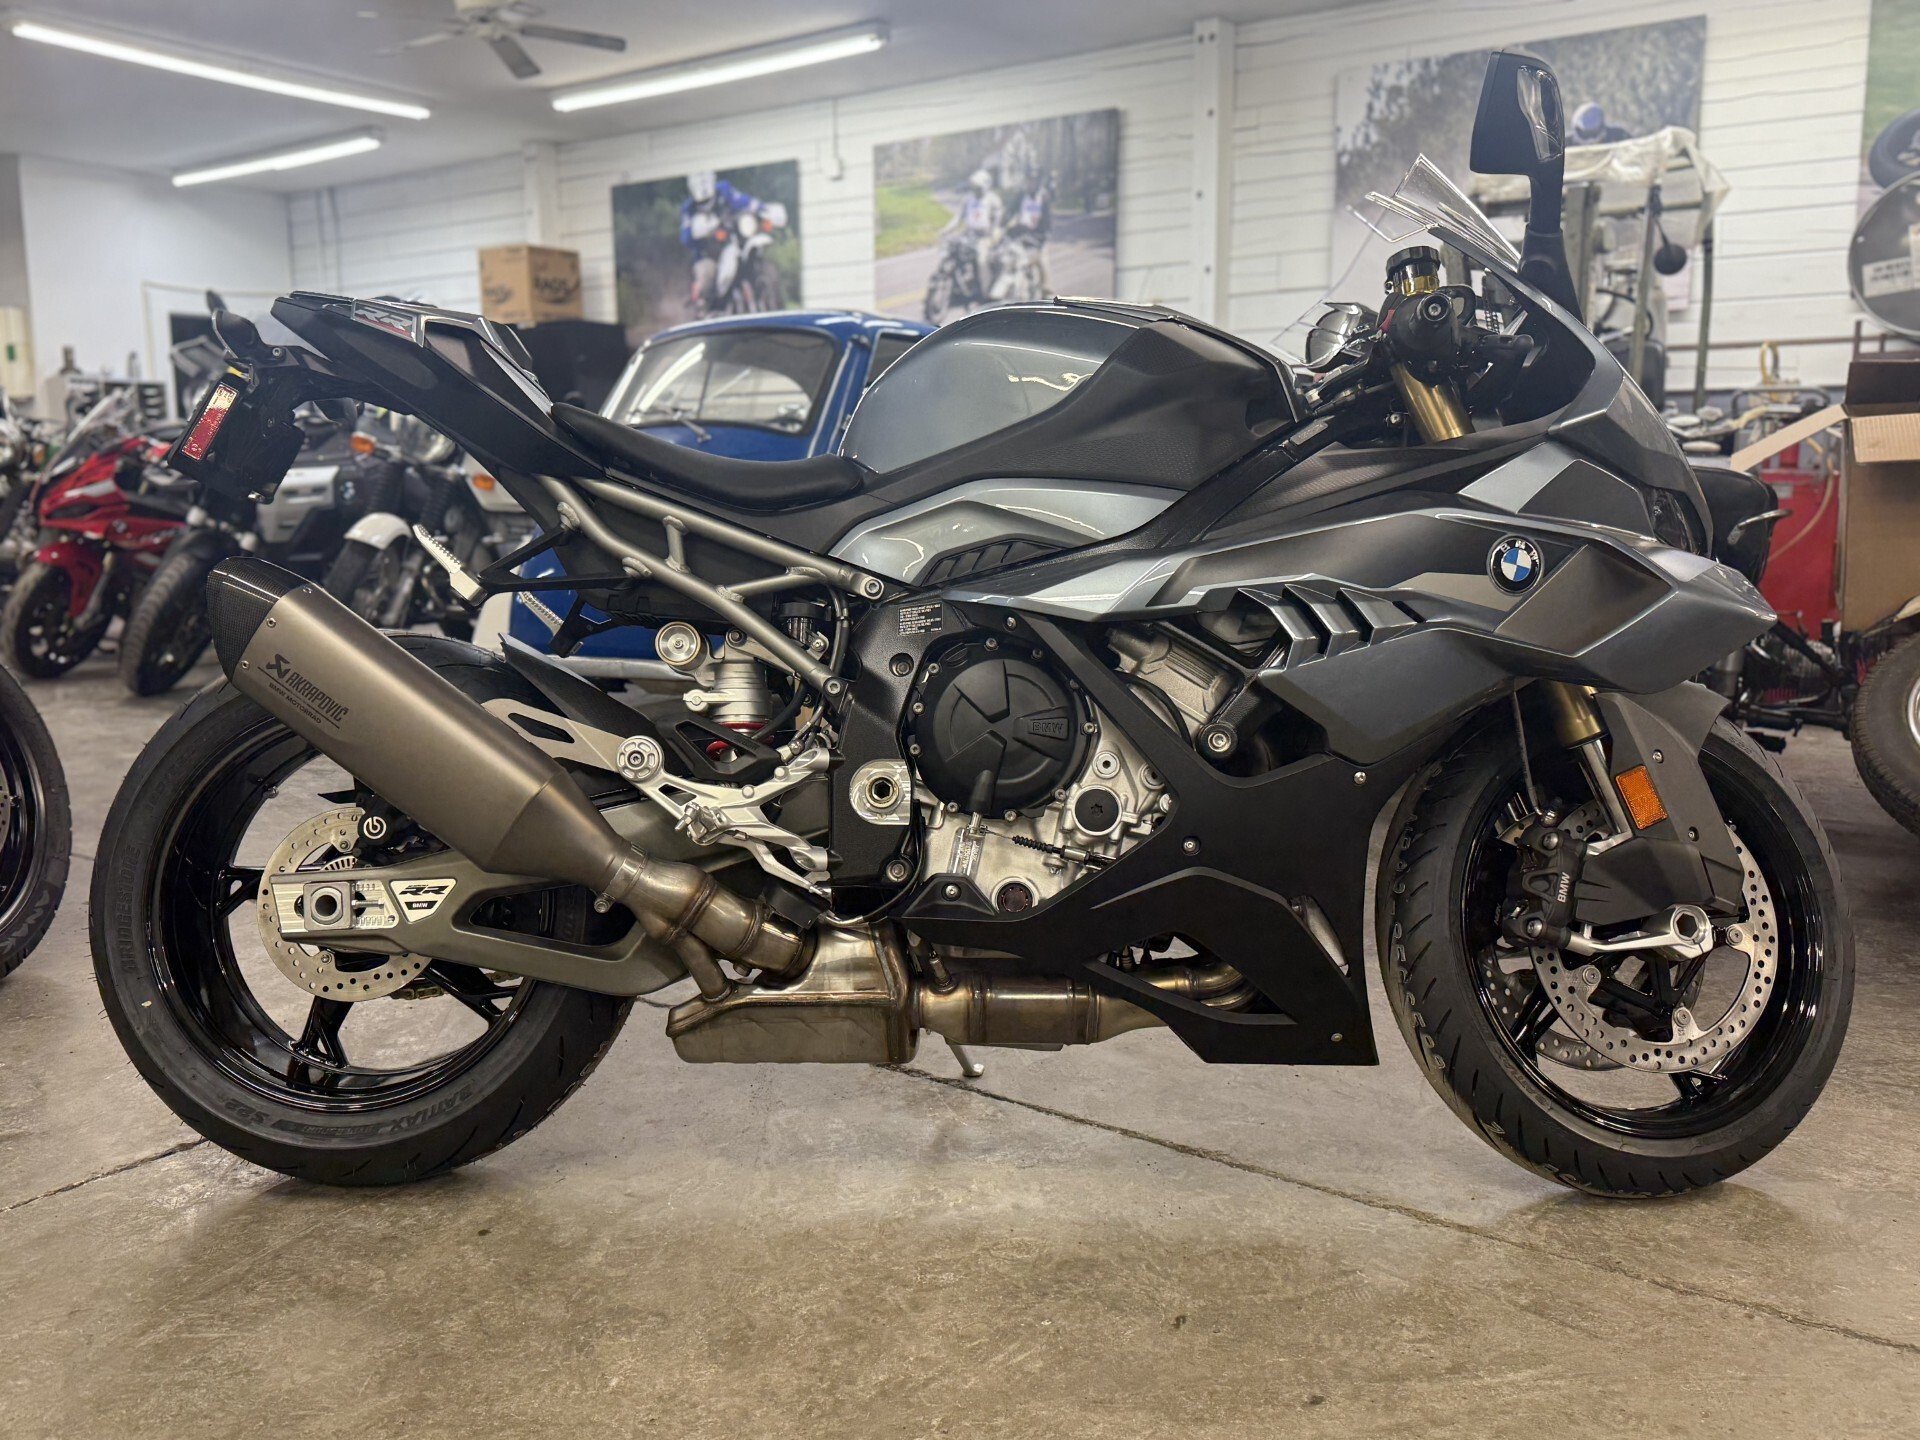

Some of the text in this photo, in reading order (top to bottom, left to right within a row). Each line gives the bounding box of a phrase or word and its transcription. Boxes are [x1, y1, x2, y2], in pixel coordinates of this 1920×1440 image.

[355, 306, 412, 331] RR
[1500, 540, 1539, 562] BMW
[269, 683, 322, 724] BMW MOTORRAD
[1031, 720, 1064, 734] BMW
[399, 885, 449, 896] RR
[1557, 872, 1571, 903] BMW
